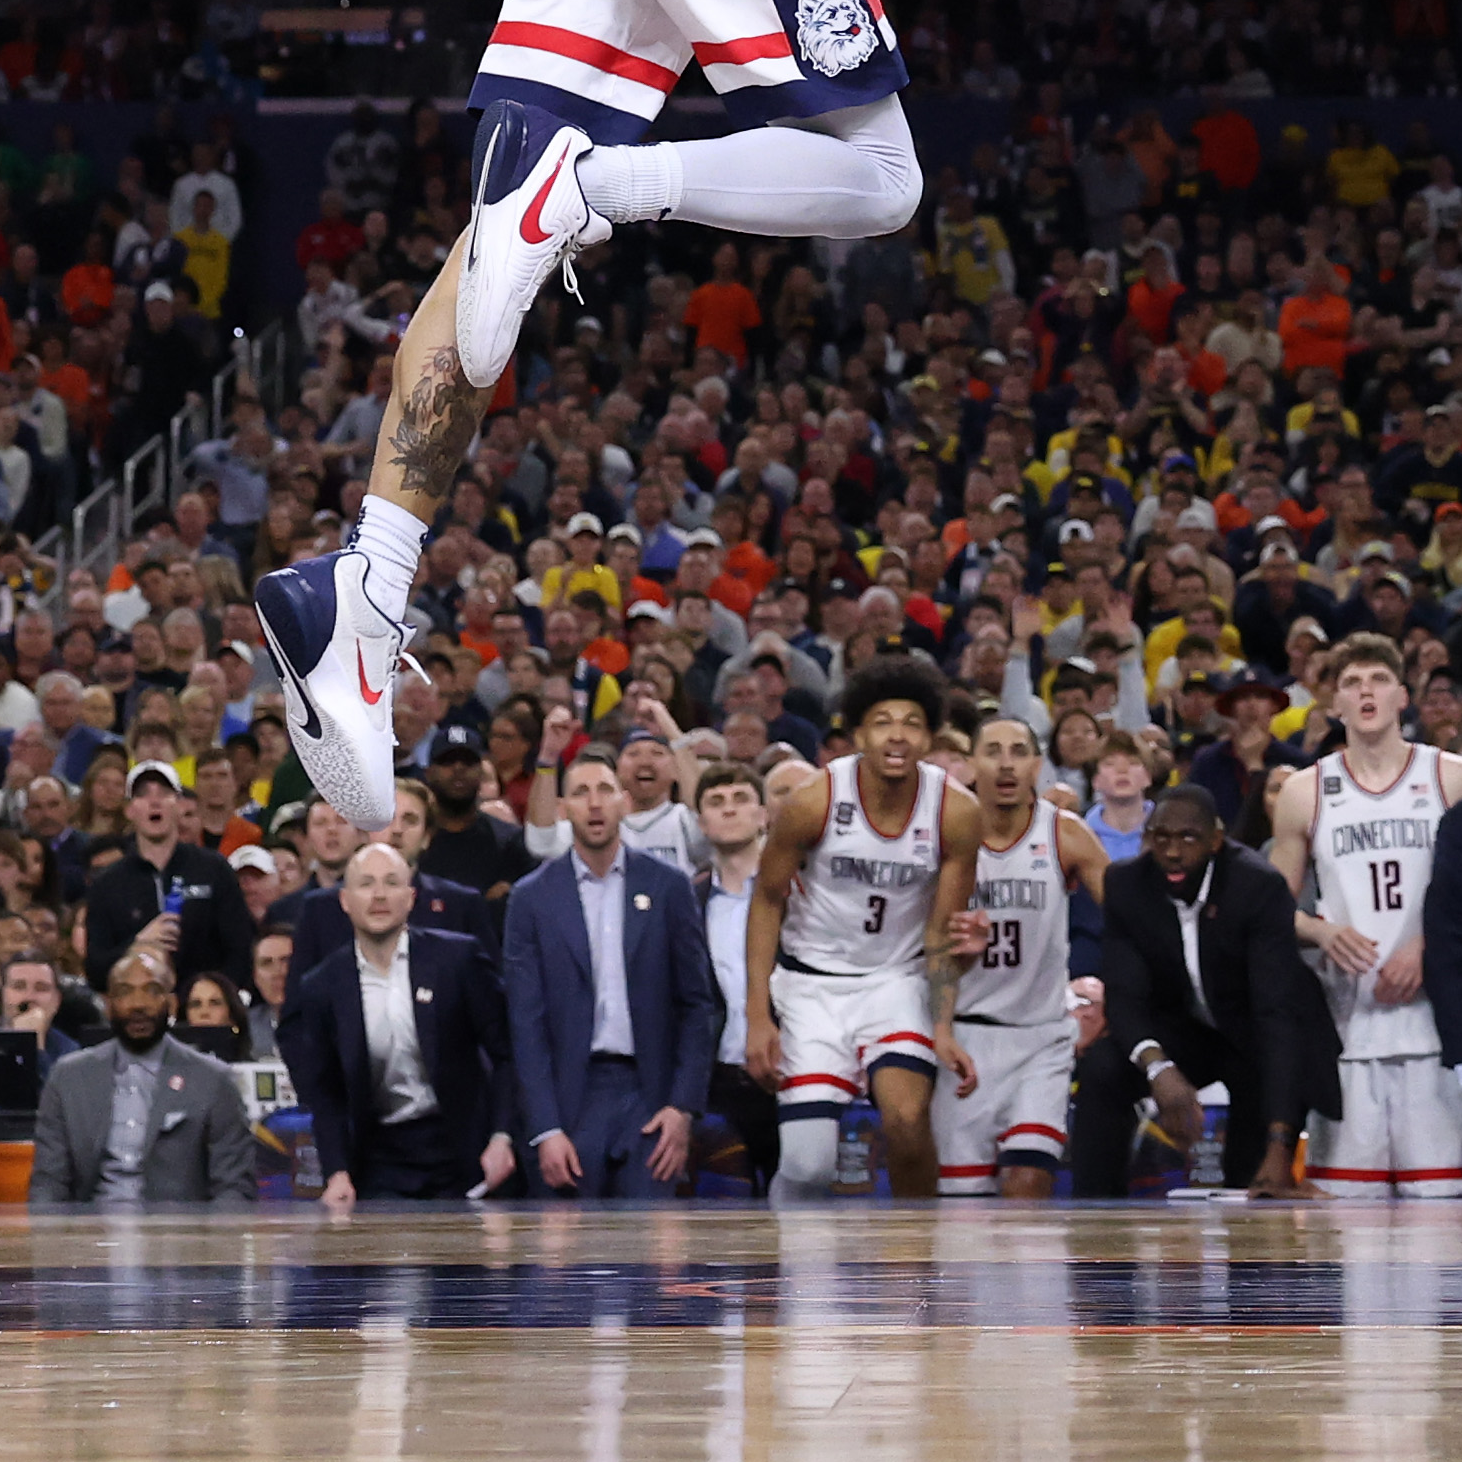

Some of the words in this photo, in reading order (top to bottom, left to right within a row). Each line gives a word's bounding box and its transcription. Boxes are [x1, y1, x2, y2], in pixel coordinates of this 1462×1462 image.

[1368, 860, 1402, 912] 12
[864, 894, 886, 934] 3
[982, 920, 1022, 969] 23
